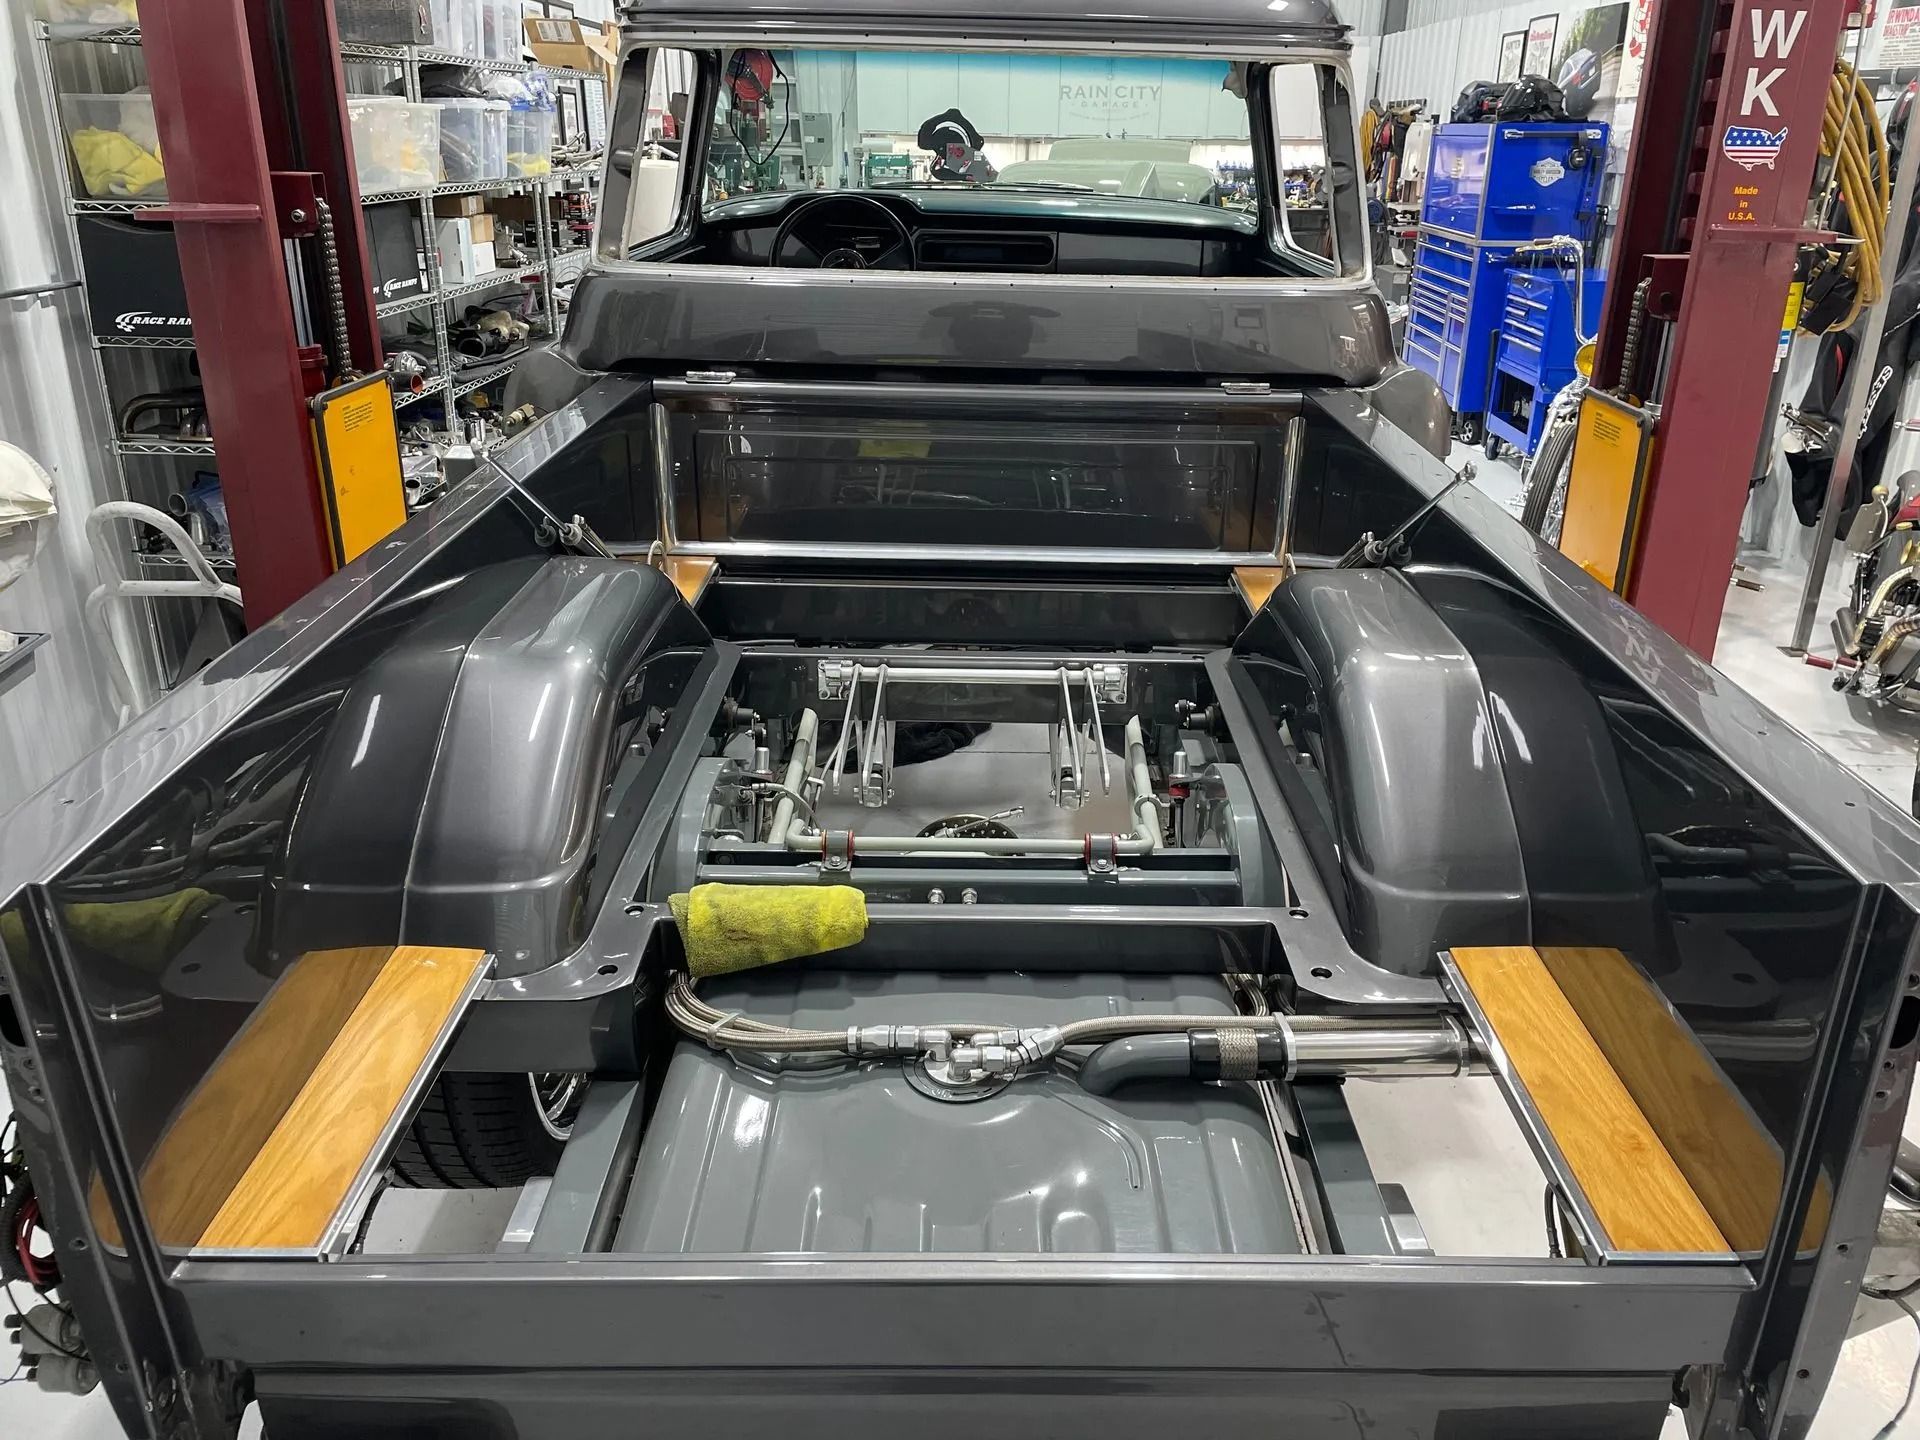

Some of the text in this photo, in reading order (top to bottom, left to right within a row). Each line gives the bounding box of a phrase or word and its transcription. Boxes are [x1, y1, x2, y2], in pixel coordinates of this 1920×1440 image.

[1060, 85, 1160, 101] RAIN CITY
[1734, 186, 1758, 195] Made
[1740, 200, 1748, 208] in
[1728, 212, 1755, 221] U.S.A.
[131, 316, 166, 325] RACE
